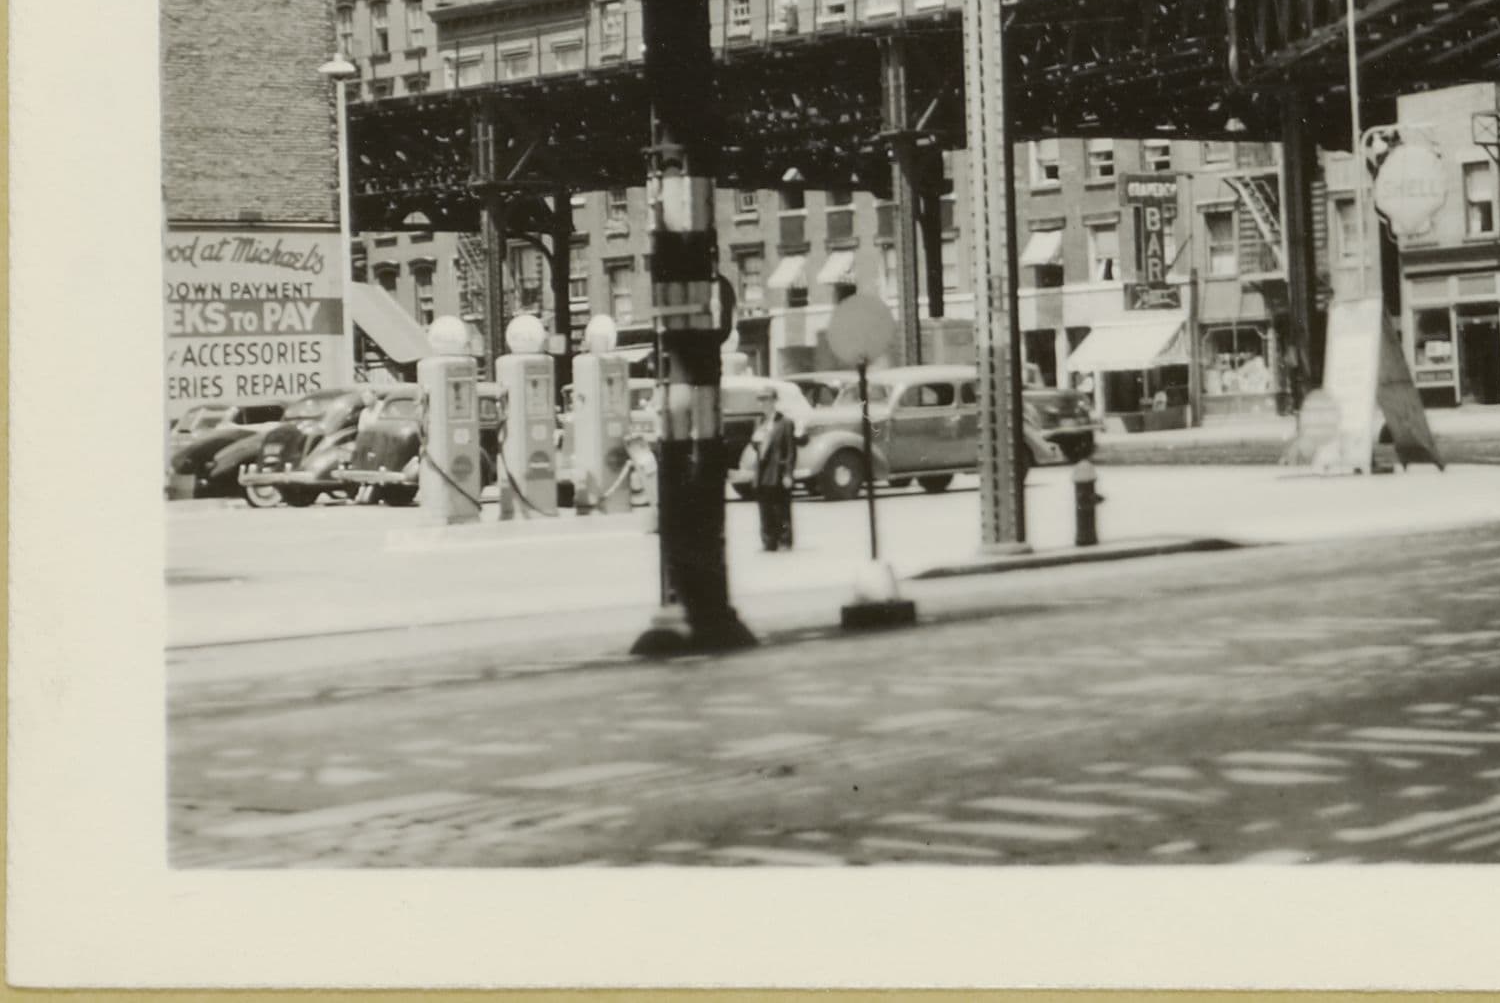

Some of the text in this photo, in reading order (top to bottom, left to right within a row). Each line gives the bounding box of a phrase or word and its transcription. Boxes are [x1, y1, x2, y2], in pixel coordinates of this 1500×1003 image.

[1381, 179, 1442, 199] SHELL
[200, 237, 231, 262] at
[230, 237, 325, 275] Michael's
[1145, 206, 1163, 283] BAR
[230, 282, 313, 299] PAYMENT
[168, 301, 227, 333] EKS
[262, 301, 320, 333] PAY
[181, 341, 321, 367] ACCESSORIES
[236, 371, 321, 396] REPAIRS
